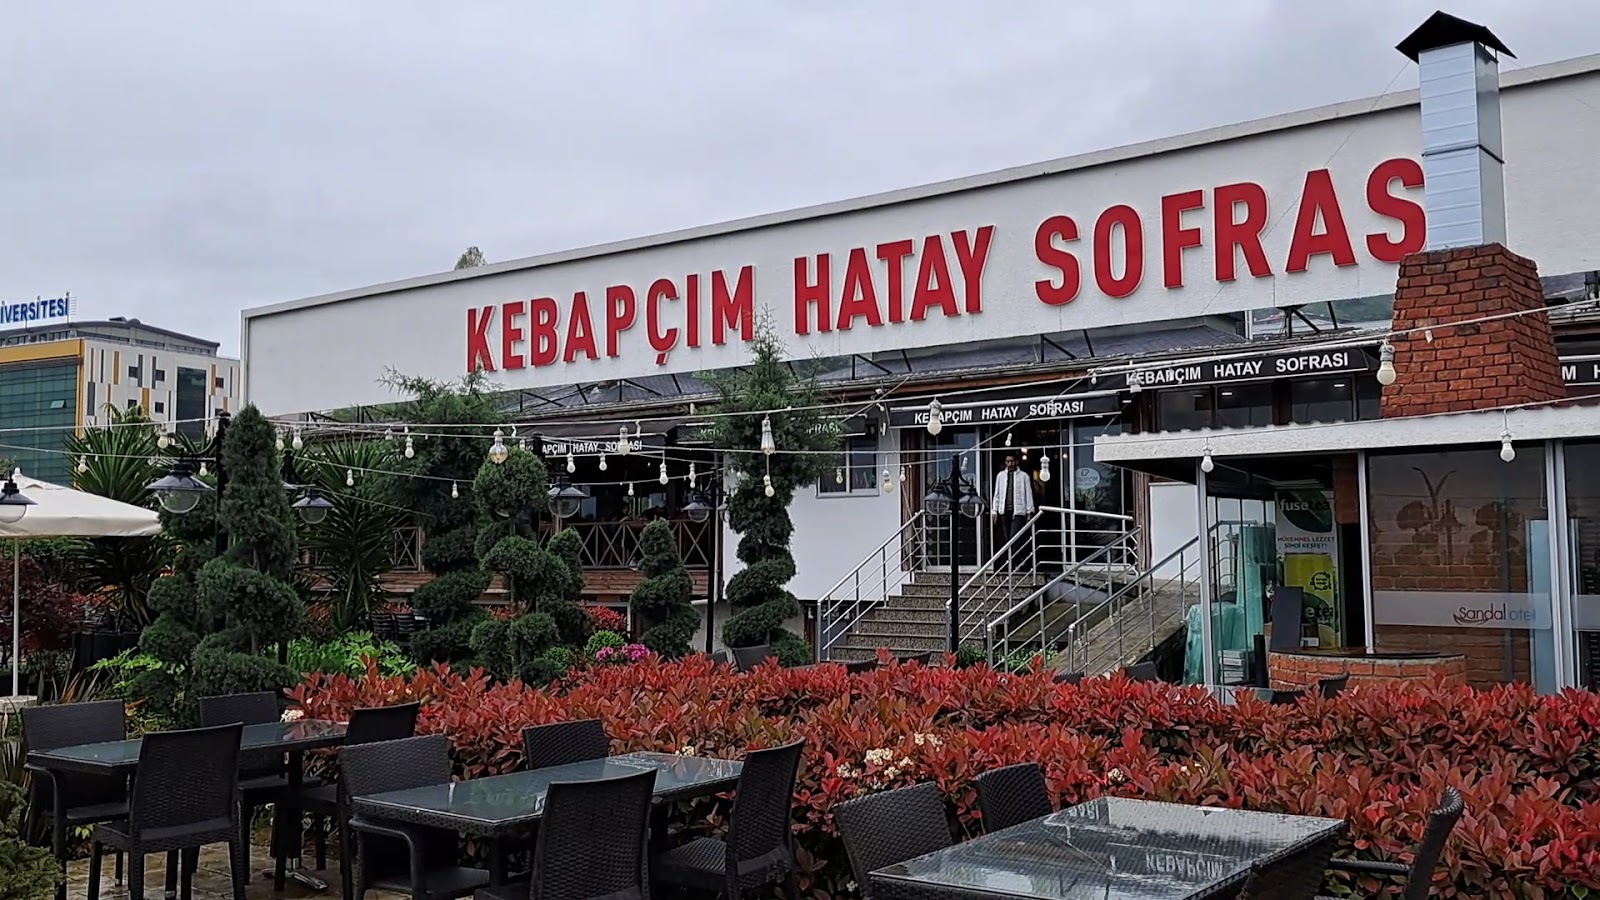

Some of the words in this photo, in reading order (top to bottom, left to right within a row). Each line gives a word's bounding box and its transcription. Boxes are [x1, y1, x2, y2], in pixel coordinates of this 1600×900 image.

[467, 265, 756, 373] KEBAPÇIM
[794, 224, 996, 335] HATAY
[1214, 361, 1262, 378] HATAY
[1275, 352, 1348, 373] SOFRASI
[914, 410, 972, 424] KEAPÇIM
[982, 406, 1019, 420] HATAY
[1029, 401, 1084, 416] SOFRASI
[573, 443, 599, 453] HATAY
[605, 441, 642, 452] SOASI
[1459, 603, 1507, 621] Sandal
[1509, 609, 1536, 621] otel
